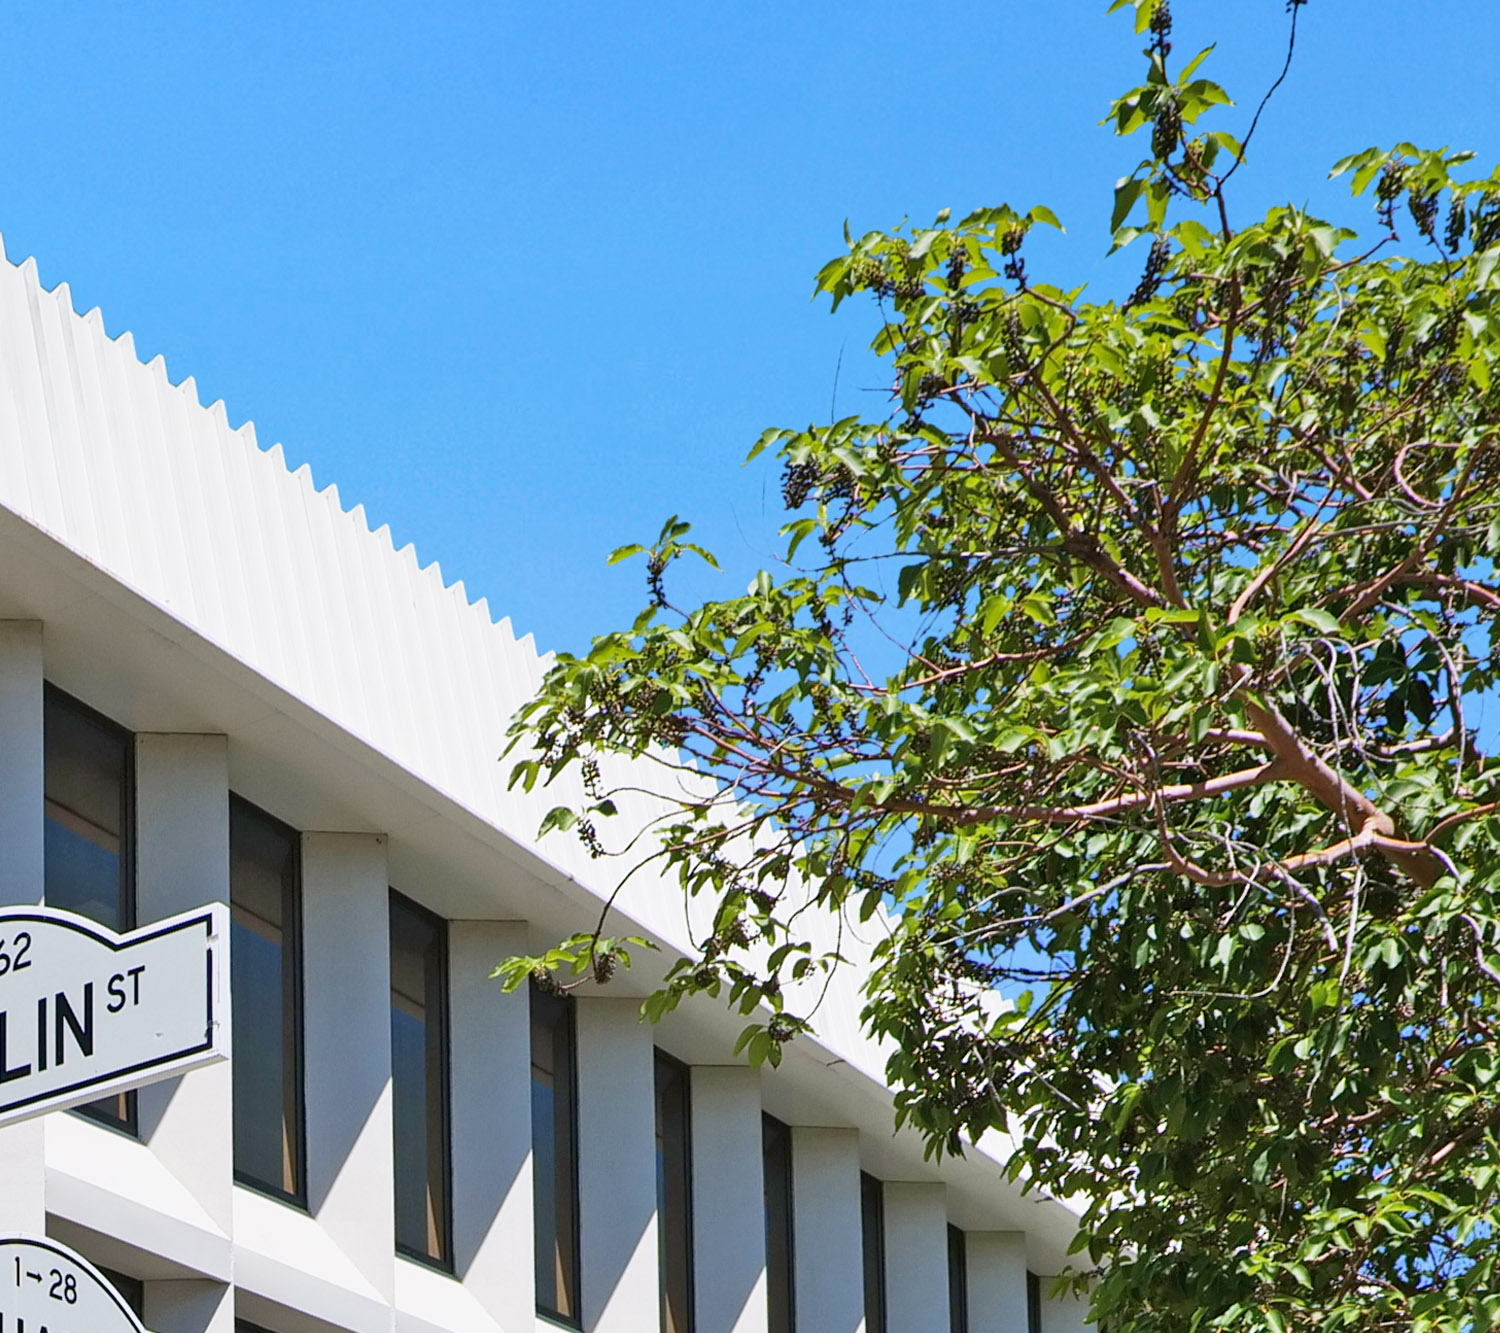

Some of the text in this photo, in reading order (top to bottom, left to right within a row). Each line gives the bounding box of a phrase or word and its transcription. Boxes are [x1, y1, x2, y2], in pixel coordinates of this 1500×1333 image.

[107, 966, 145, 1013] ST
[14, 1256, 77, 1304] 1 28
